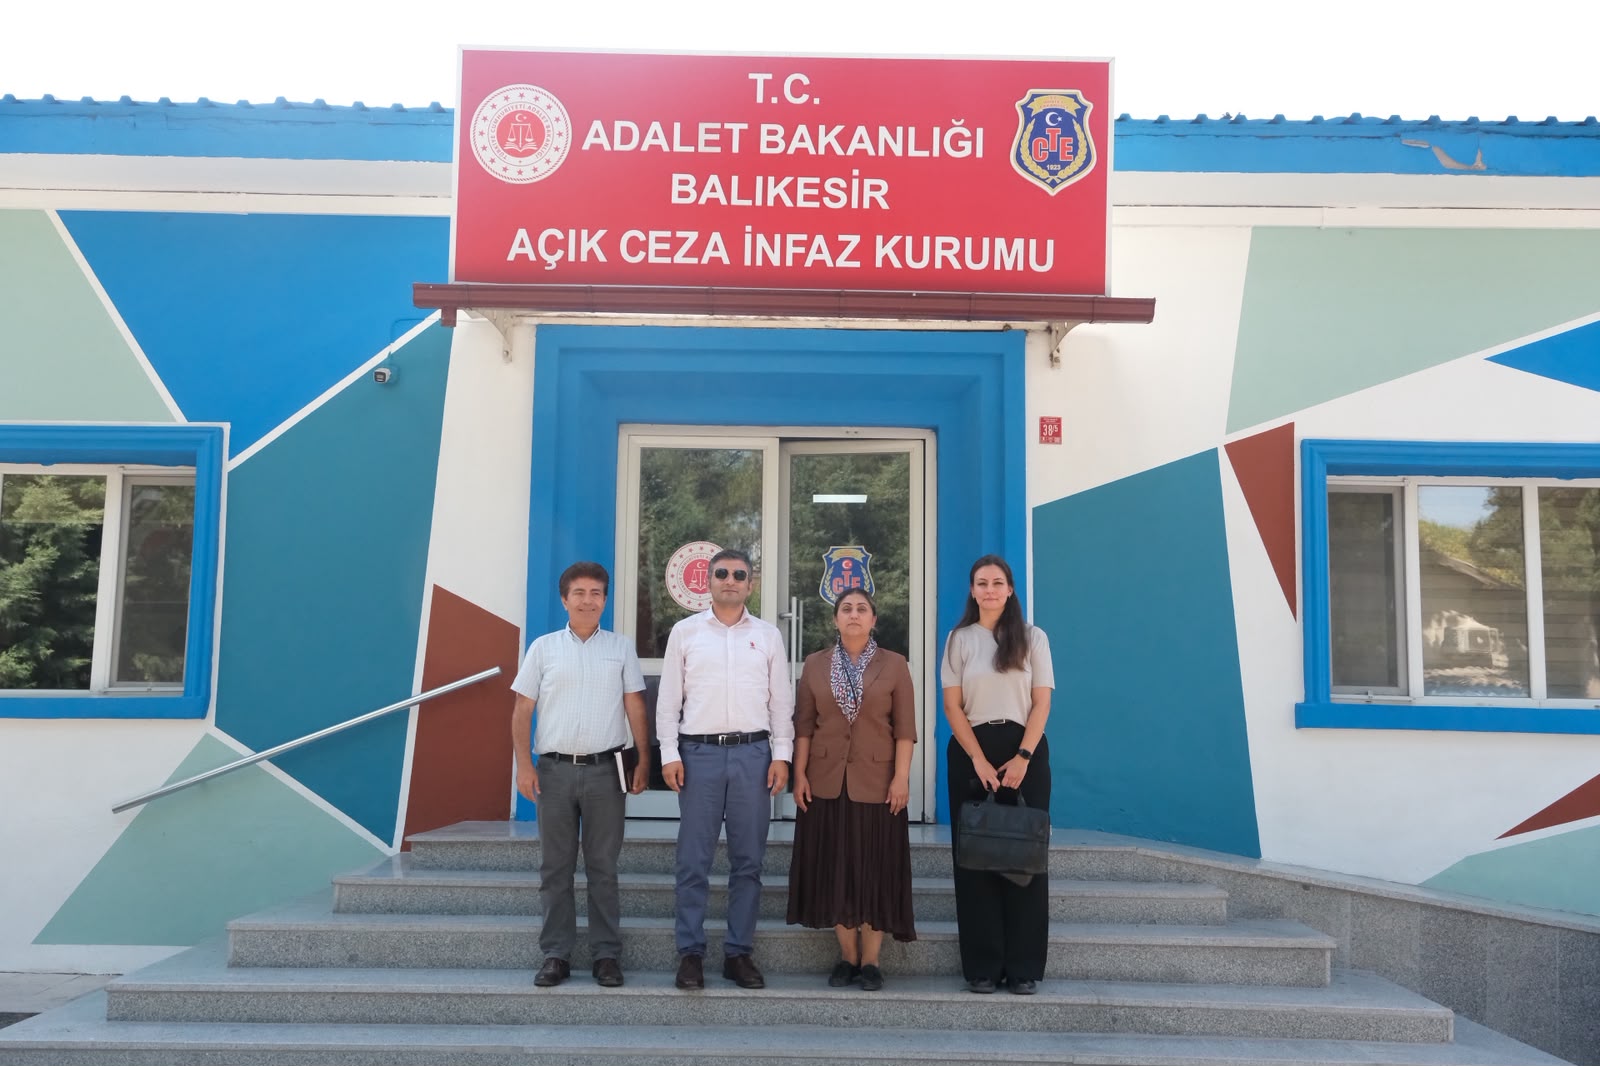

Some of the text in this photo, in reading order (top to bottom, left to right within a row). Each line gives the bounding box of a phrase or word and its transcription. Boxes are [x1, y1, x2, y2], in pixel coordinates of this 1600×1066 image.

[748, 72, 820, 105] T.C.
[582, 118, 984, 159] ADALET BAKANLIĞI
[671, 168, 890, 210] BALIKESİR
[507, 225, 1055, 274] AÇIK CEZA İNFAZ KURUMU
